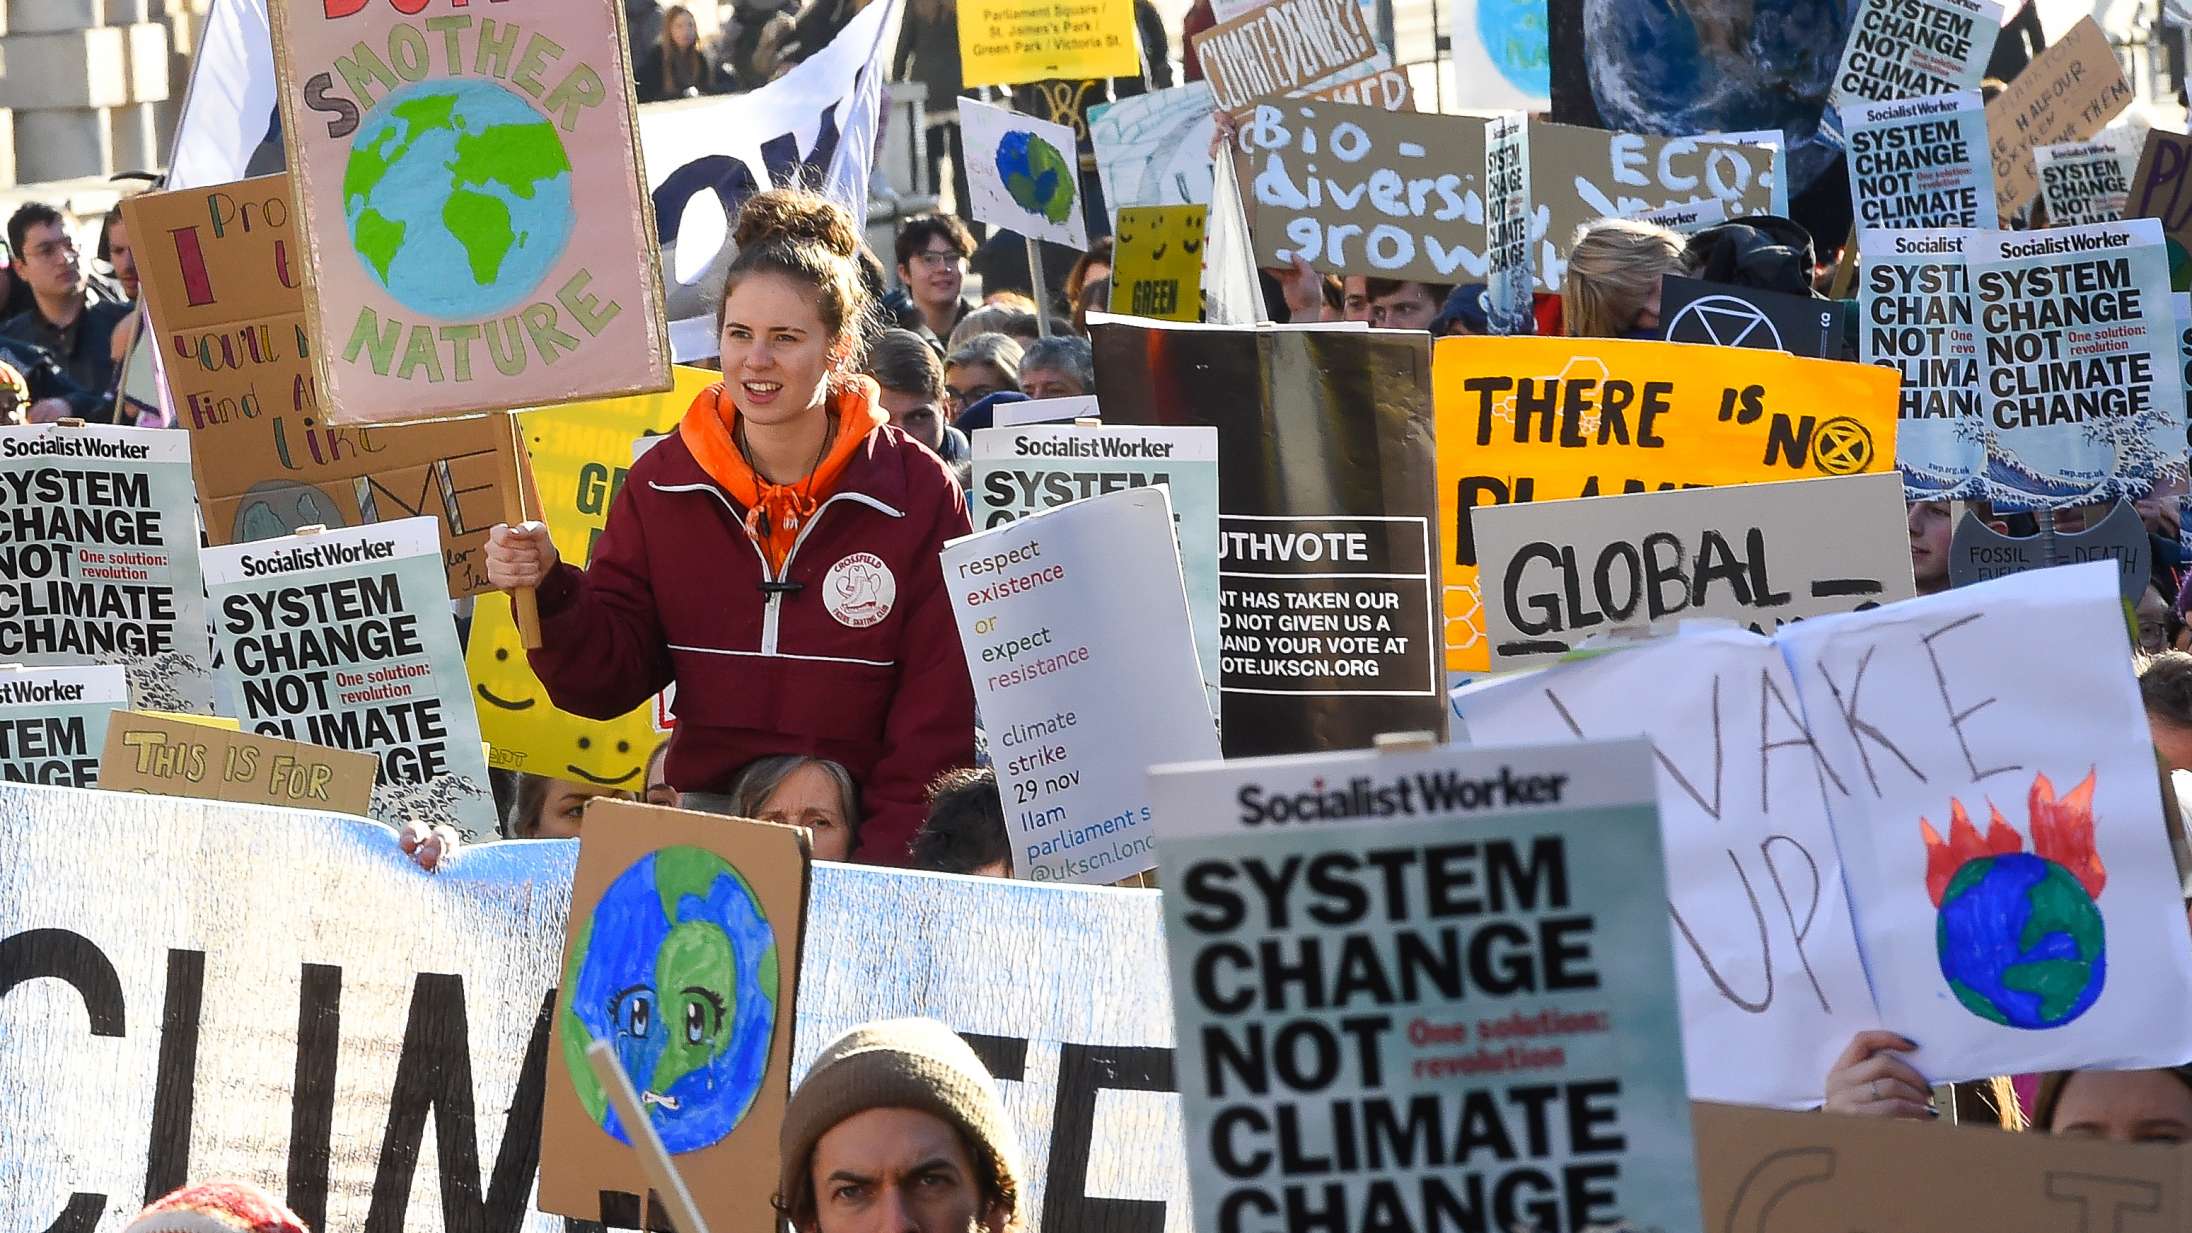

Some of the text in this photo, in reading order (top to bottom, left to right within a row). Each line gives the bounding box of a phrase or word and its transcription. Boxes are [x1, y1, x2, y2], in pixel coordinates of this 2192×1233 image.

[983, 4, 1097, 21] Parliament Square
[1063, 20, 1090, 32] Park
[1868, 0, 1974, 39] SYSTEM
[973, 43, 1010, 56] Green
[1015, 40, 1041, 53] Park
[1053, 37, 1102, 51] Victoria
[1854, 30, 1911, 63] NOT
[1863, 10, 1972, 62] CHANGE
[1852, 119, 1961, 153] SYSTEM
[1855, 141, 1969, 175] CHANGE
[2043, 159, 2122, 183] SYSTEM
[1489, 168, 1523, 200] CHAGE
[1858, 172, 1914, 199] NOT
[2048, 177, 2128, 200] CHANGE
[1861, 186, 1978, 221] CLIMATE
[2051, 198, 2092, 218] NOT
[1490, 242, 1525, 275] CHAGE
[1895, 236, 1964, 254] Socialist
[166, 224, 218, 308] I
[1978, 258, 2132, 302] SYSTEM
[1131, 278, 1179, 317] GREEN
[1870, 295, 1973, 325] CHAN
[1982, 289, 2143, 335] CHANGE
[342, 268, 622, 383] NATURE
[1871, 327, 1945, 357] NOT
[1950, 329, 1973, 342] One
[2068, 325, 2147, 344] One solution:
[1951, 344, 1976, 354] revo
[1986, 330, 2062, 367] NOT
[2070, 338, 2129, 356] revolution
[1989, 352, 2153, 398] CLIMATE
[185, 381, 263, 431] Find
[1463, 375, 1674, 449] THERE
[1717, 383, 1765, 426] IS
[1992, 385, 2152, 430] CHANGE
[0, 467, 152, 508] YSTEM
[79, 549, 169, 566] One solution:
[834, 554, 882, 573] CROSSFIELD
[959, 539, 1041, 581] respect
[1969, 545, 2031, 564] FOSSIL
[82, 566, 149, 581] revolution
[966, 562, 1065, 607] existence
[1502, 526, 1794, 638] GLOBAL
[0, 581, 177, 621] CLIMATE
[222, 573, 404, 635] SYSTEM
[1241, 591, 1281, 610] HAS
[1284, 592, 1351, 610] TAKEN
[1355, 592, 1400, 611] OUR
[0, 619, 176, 658] CHANGE
[975, 615, 999, 636] or
[1235, 614, 1274, 631] NOT
[1278, 615, 1339, 632] GIVEN
[1344, 615, 1373, 632] US
[1376, 615, 1391, 632] A
[233, 614, 424, 677] CHANGE
[981, 625, 1053, 666] expect
[1219, 636, 1409, 655] AND YOUR VOTE AT
[336, 662, 431, 688] One solution:
[987, 644, 1091, 693] resistance
[1219, 657, 1380, 677] OTE.UKSCN.ORG
[12, 679, 84, 703] Worker
[242, 671, 330, 720] NOT
[340, 683, 413, 705] revolution
[1001, 709, 1078, 749] climate
[1546, 611, 2024, 822] WAKE
[122, 730, 333, 801] THIS IS FOR
[1007, 743, 1068, 778] strike
[1013, 769, 1082, 805] 29 nov
[1025, 810, 1136, 866] parliament
[1182, 834, 1572, 935] SYSTEM
[1667, 832, 1832, 1015] UP
[1191, 915, 1602, 1016] CHANGE
[1407, 1008, 1611, 1047] One solution:
[1200, 1013, 1393, 1099] NOT
[1411, 1043, 1567, 1080] revolution
[1209, 1078, 1628, 1181] CLIMATE
[1215, 1161, 1622, 1233] CHANGE
